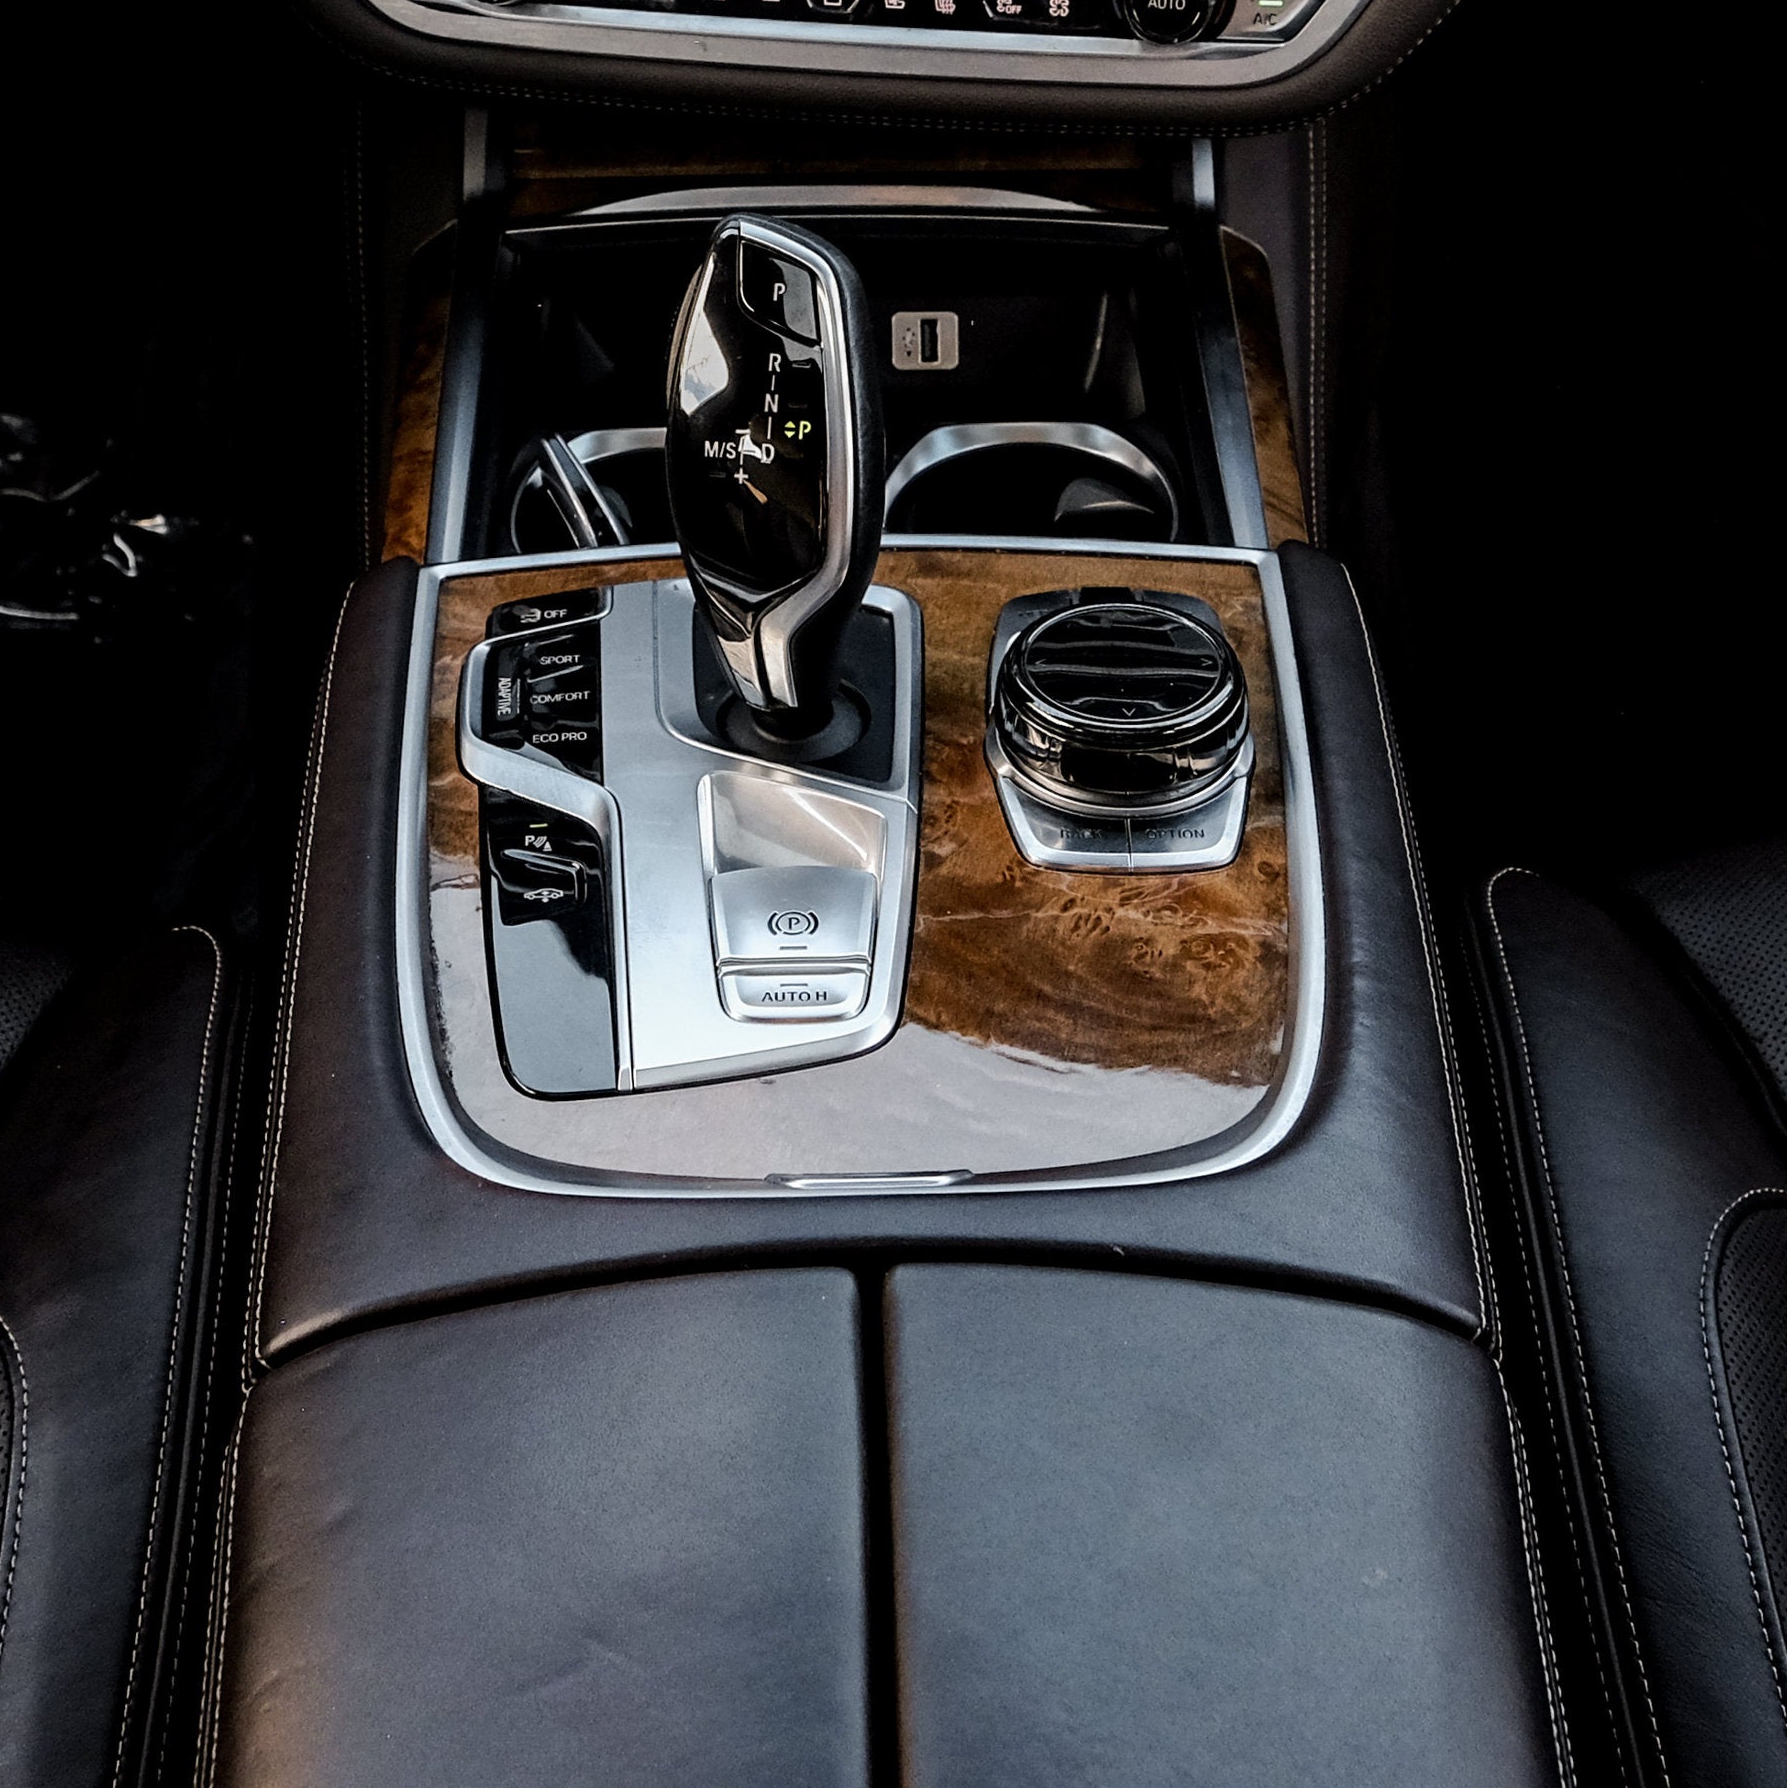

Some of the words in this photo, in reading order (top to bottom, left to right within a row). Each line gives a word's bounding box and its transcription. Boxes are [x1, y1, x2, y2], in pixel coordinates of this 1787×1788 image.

[772, 282, 787, 302] P
[768, 352, 782, 373] R
[764, 393, 780, 414] N
[798, 420, 812, 441] P
[703, 440, 737, 460] M/S
[761, 442, 775, 464] D
[543, 608, 568, 619] OFF
[539, 654, 581, 665] SPORT
[497, 677, 512, 717] ADAPTIVE
[530, 690, 591, 705] COMFORT
[532, 732, 559, 744] ECO
[560, 731, 588, 742] PRO
[1059, 827, 1103, 840] BACK
[1145, 827, 1206, 840] OPTION
[761, 990, 812, 1003] AUTO
[815, 990, 828, 1002] H
